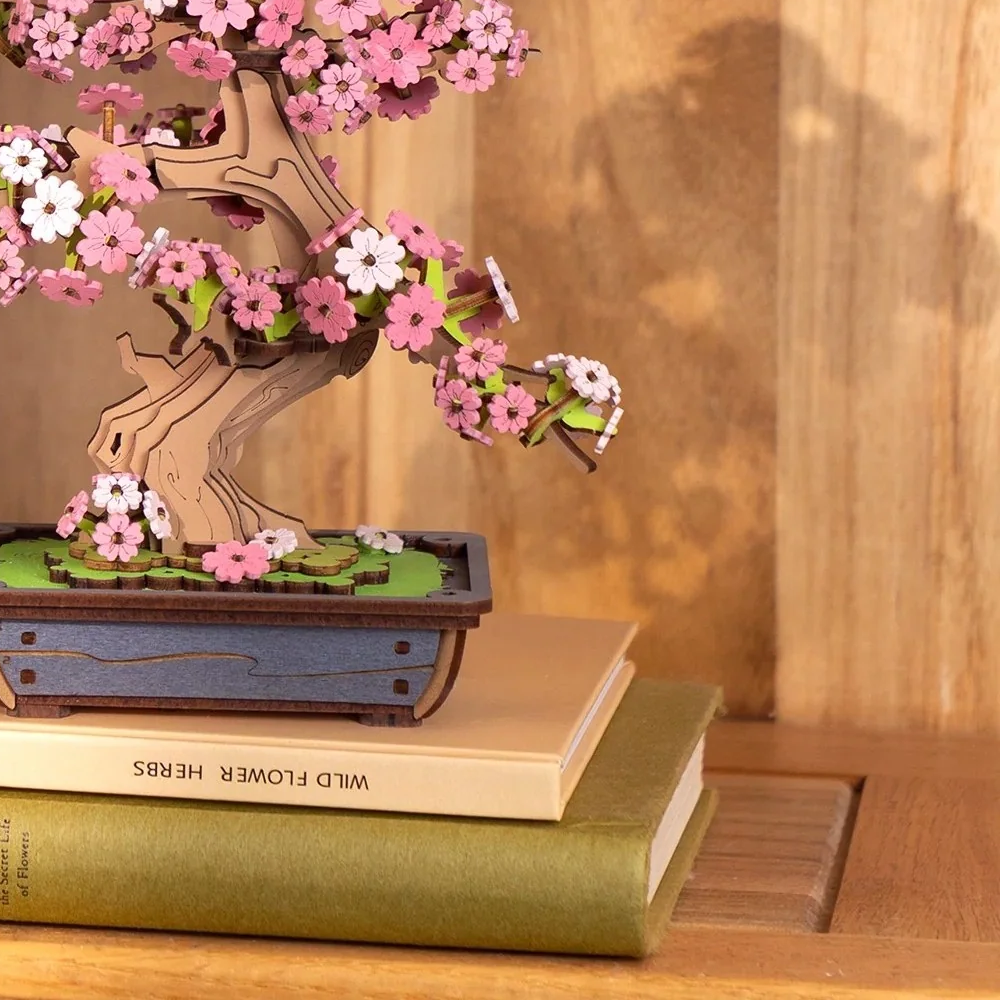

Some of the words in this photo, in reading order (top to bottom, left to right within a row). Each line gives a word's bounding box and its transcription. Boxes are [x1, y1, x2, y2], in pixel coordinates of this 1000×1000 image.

[133, 760, 203, 779] HERBS
[220, 766, 307, 787] FLOWER
[316, 772, 369, 790] WILD
[17, 831, 30, 879] Flowers
[17, 884, 29, 897] of
